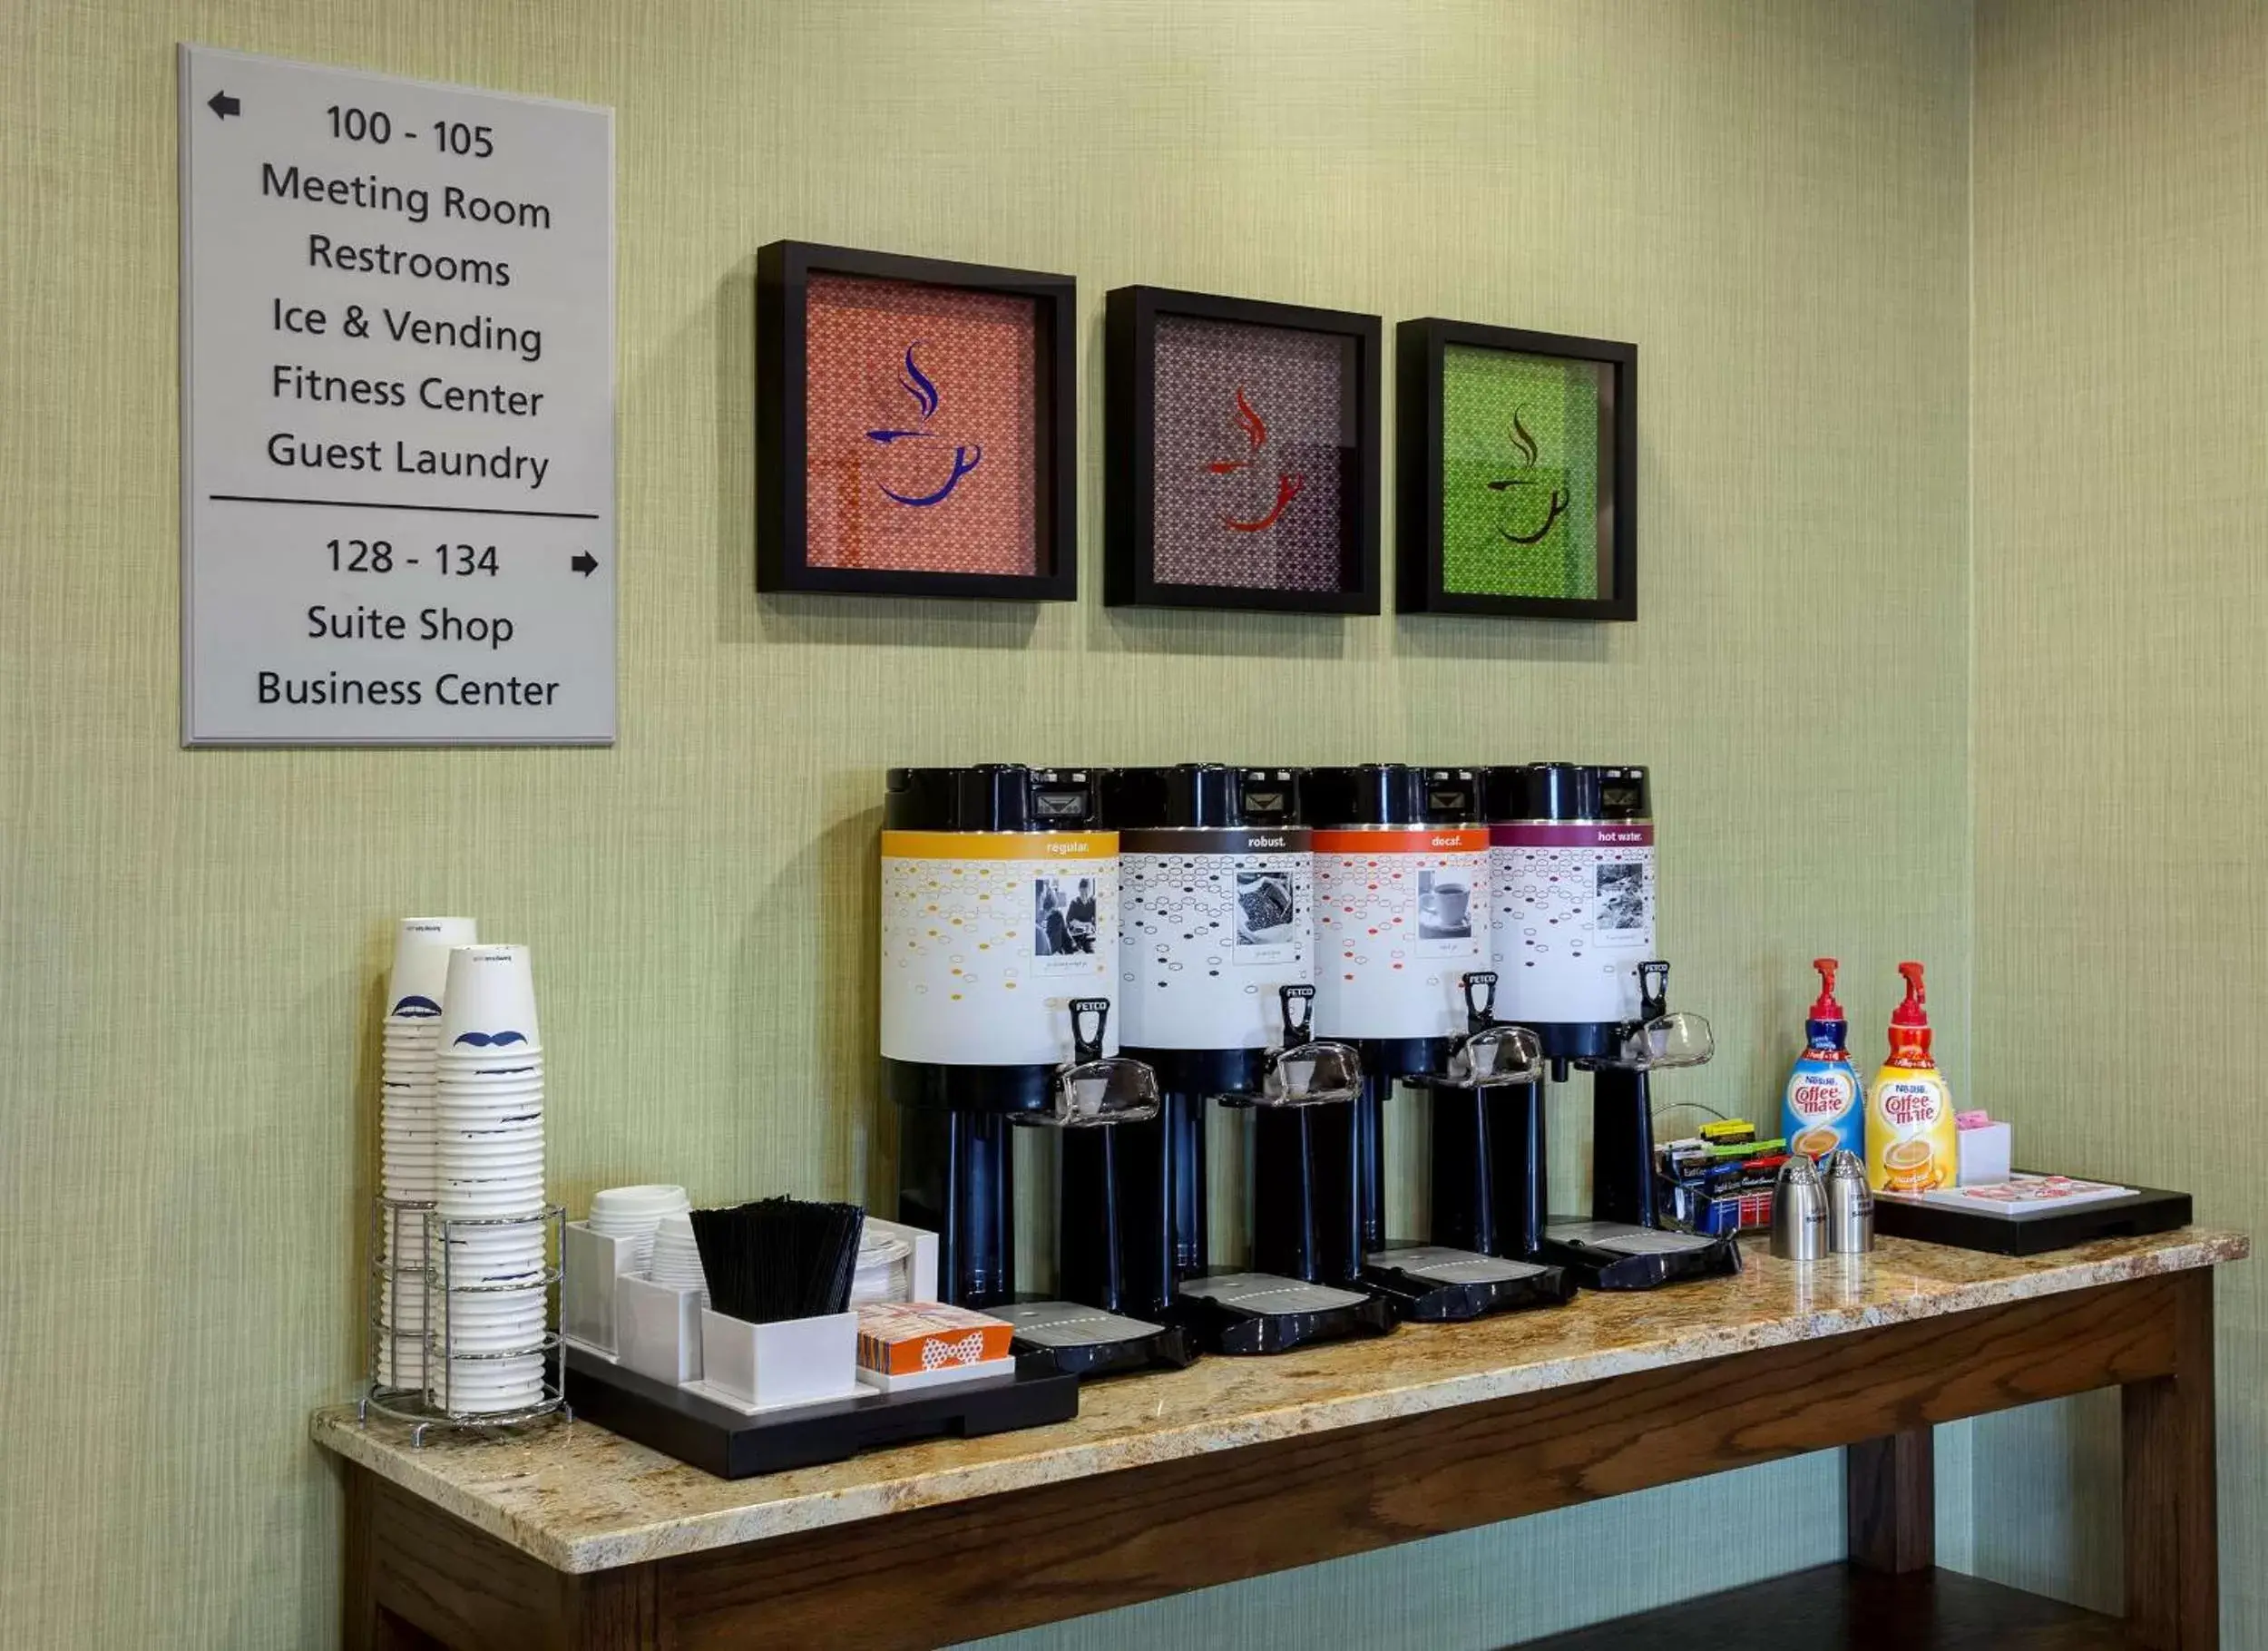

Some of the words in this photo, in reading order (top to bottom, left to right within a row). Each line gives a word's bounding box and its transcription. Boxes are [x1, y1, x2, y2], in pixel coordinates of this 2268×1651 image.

[327, 105, 391, 145] 100
[434, 121, 494, 158] 105
[262, 162, 429, 223] Meeting
[445, 186, 550, 230] Room
[309, 234, 510, 287] Restrooms
[274, 298, 327, 335] Ice
[343, 305, 370, 338] &
[383, 308, 542, 362] Vending
[273, 365, 406, 407] Fitness
[419, 377, 544, 416] Center
[268, 433, 382, 472] Guest
[396, 441, 550, 490] Laundry
[327, 539, 393, 573] 128
[435, 543, 500, 577] 134
[308, 605, 406, 640] Suite
[420, 608, 513, 650] Shop
[259, 670, 422, 706] Business
[435, 673, 560, 706] Center
[1598, 831, 1617, 842] hot
[1076, 1001, 1107, 1011] FETCO
[1286, 988, 1314, 997] FETCO
[1804, 1098, 1843, 1114] mate
[1896, 1107, 1934, 1125] mate
